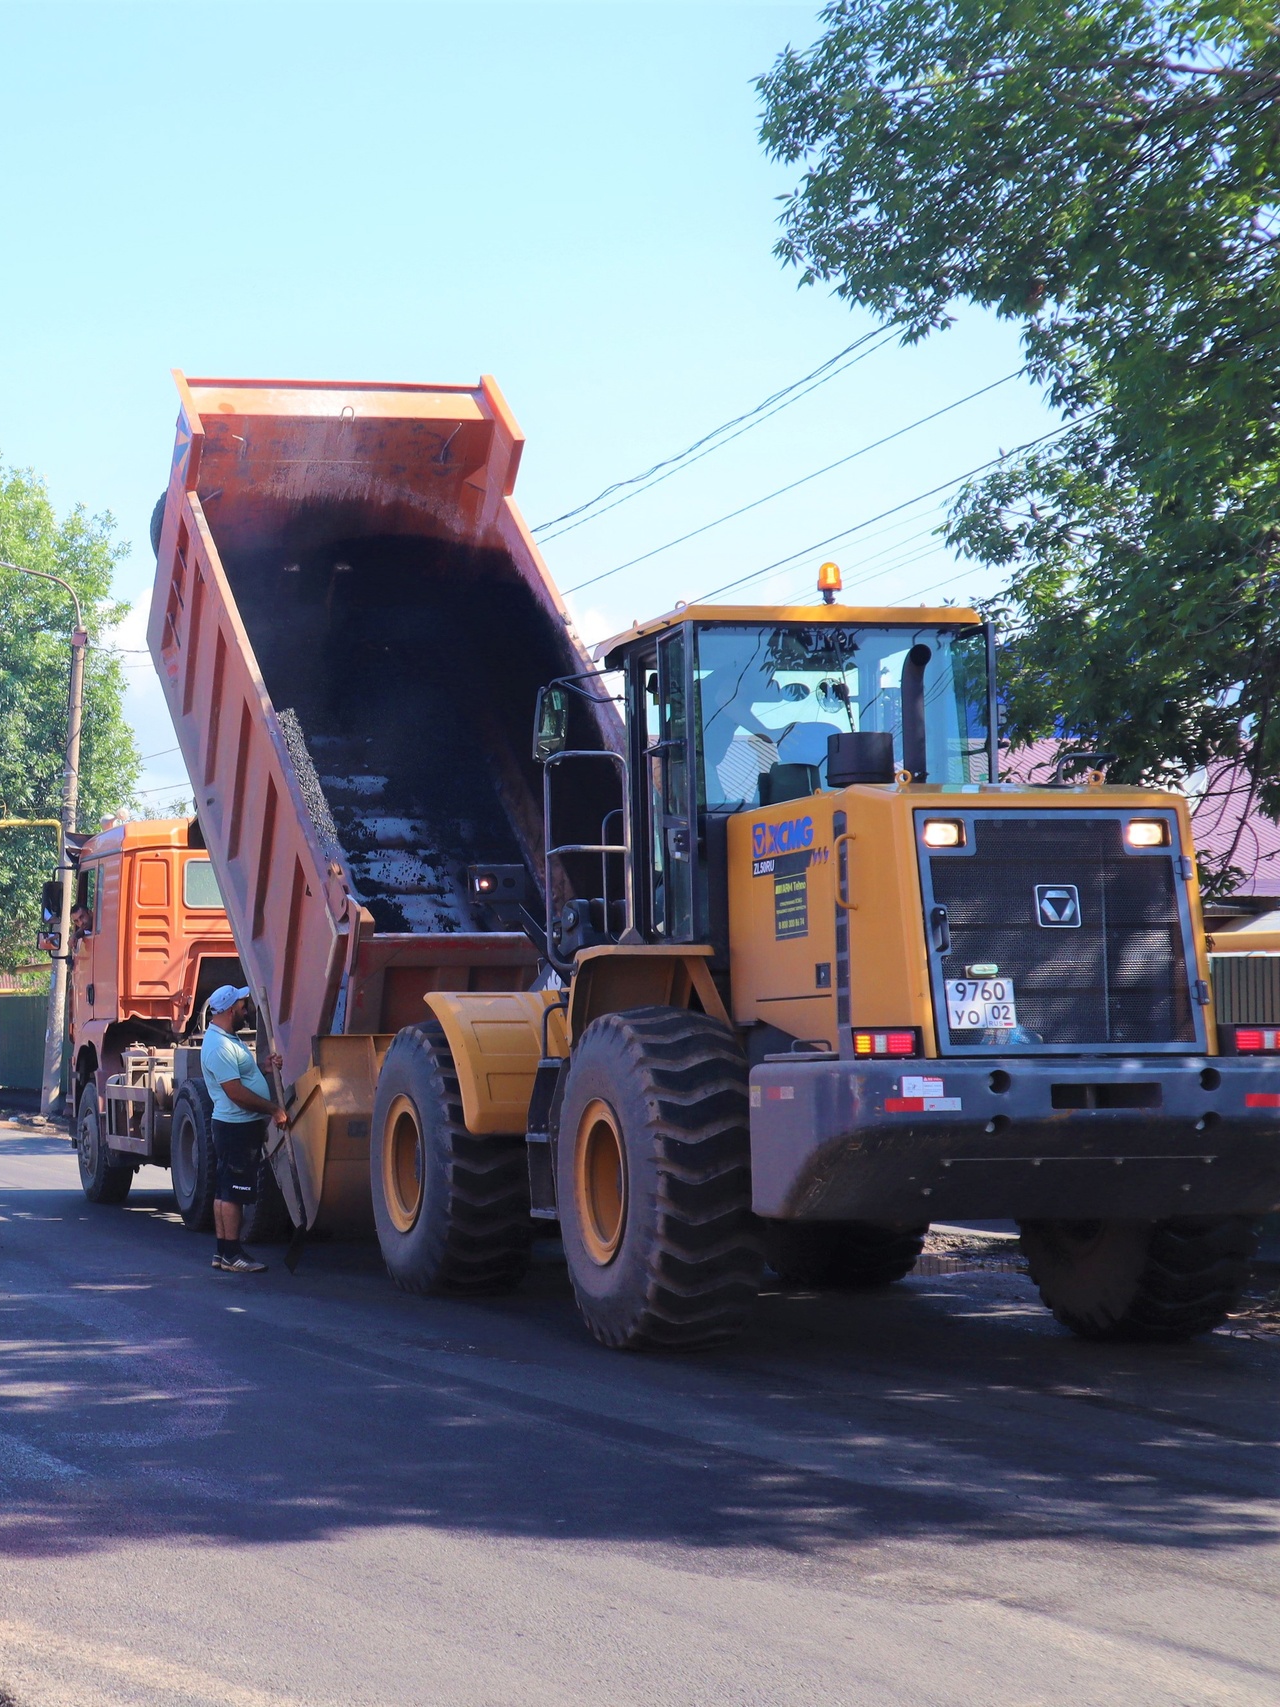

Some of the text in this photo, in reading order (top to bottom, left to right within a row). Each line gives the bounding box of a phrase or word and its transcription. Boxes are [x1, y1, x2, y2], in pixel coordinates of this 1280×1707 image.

[767, 816, 814, 855] XCMG
[955, 982, 1005, 1001] 9760
[991, 1005, 1011, 1020] 02
